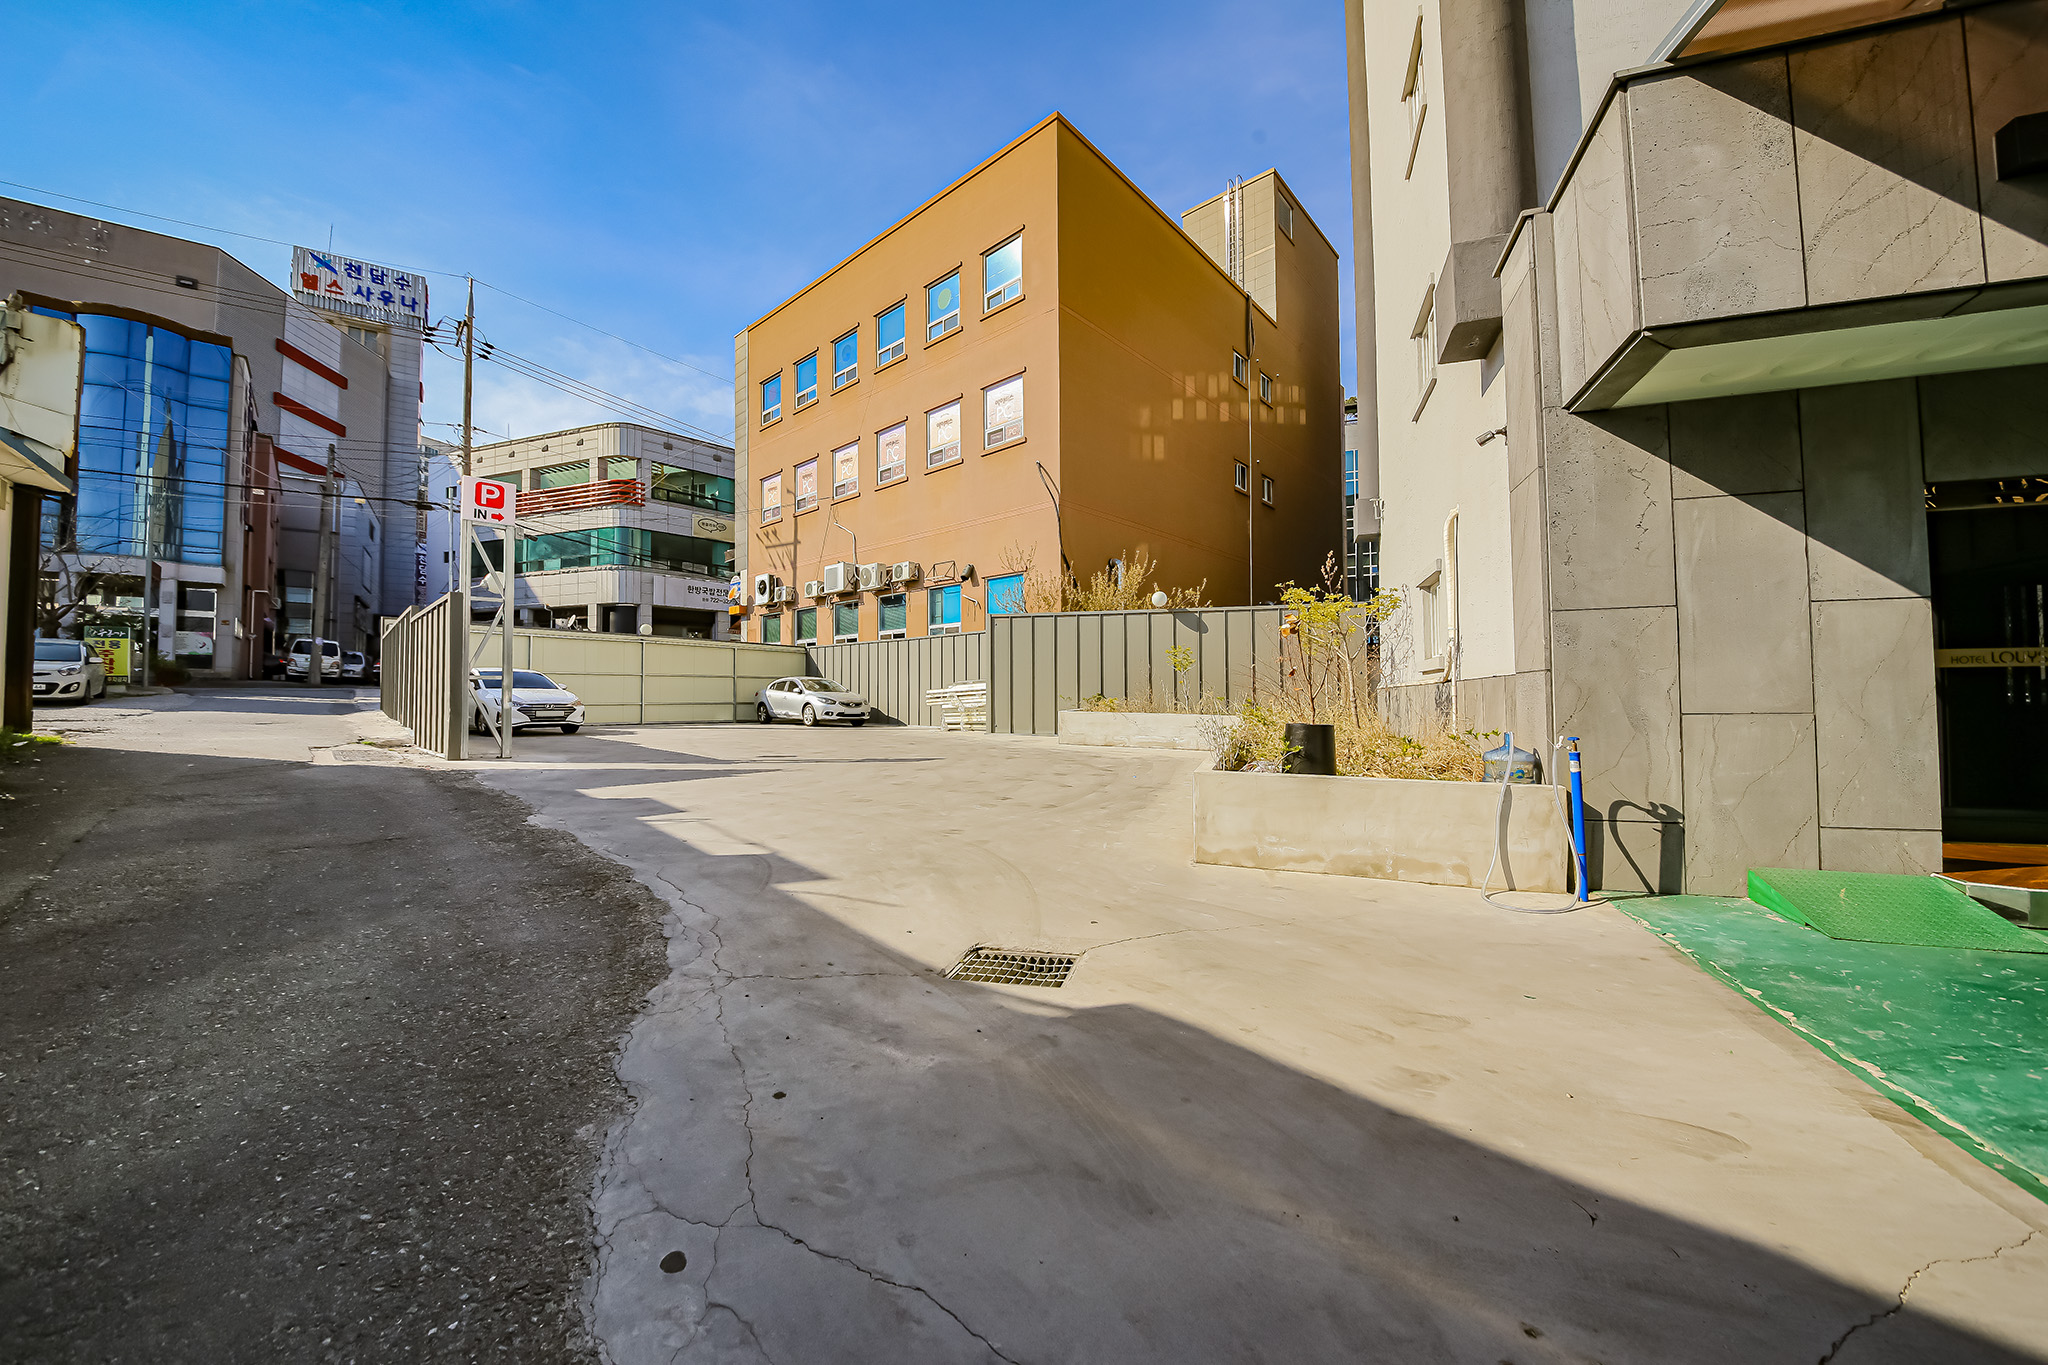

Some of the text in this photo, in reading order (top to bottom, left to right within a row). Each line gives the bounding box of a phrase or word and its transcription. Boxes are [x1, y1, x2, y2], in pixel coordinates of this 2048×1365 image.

[353, 285, 419, 313] 사우나
[481, 485, 500, 504] P
[474, 508, 487, 520] IN
[93, 639, 121, 649] 전용
[1950, 655, 1989, 665] HOTEL
